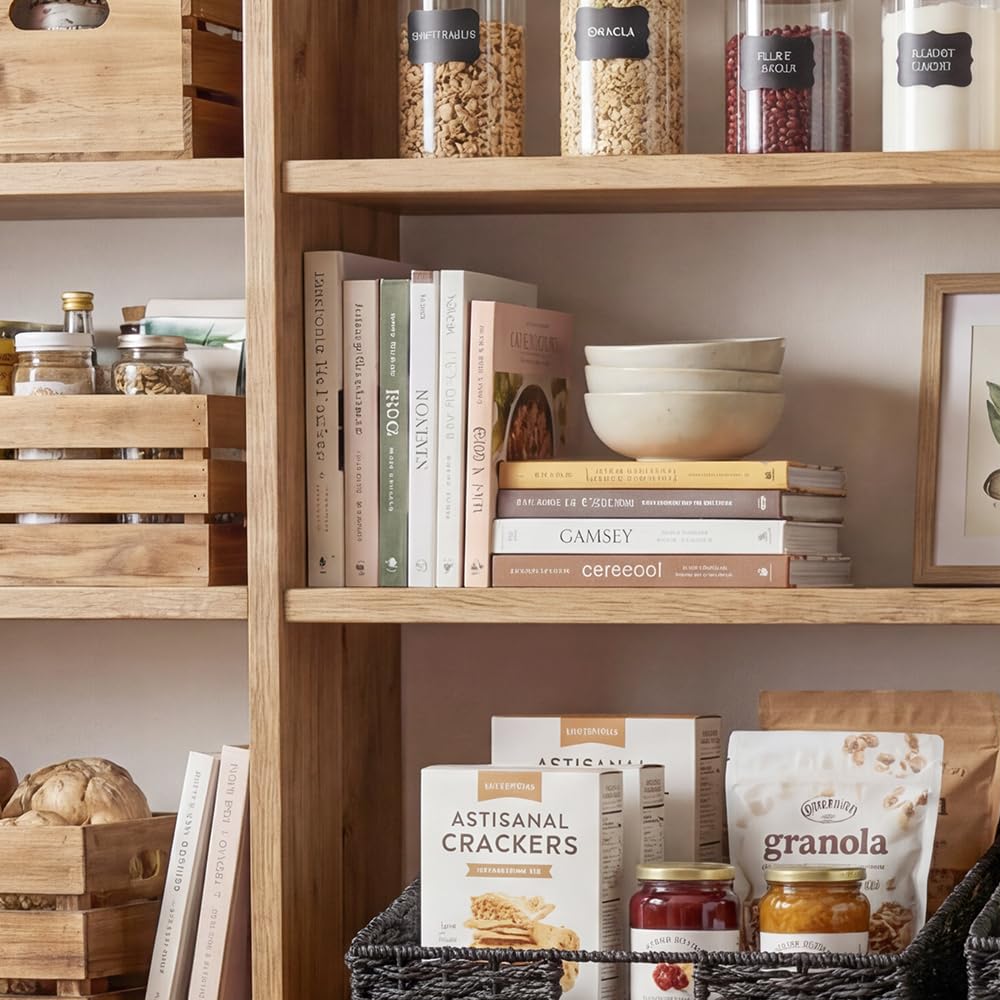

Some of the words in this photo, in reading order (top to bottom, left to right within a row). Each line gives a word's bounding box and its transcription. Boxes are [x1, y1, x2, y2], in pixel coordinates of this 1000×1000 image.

[559, 528, 633, 545] GAMSEY
[451, 811, 569, 830] ASTISANAL
[442, 833, 579, 856] CRACKERS
[763, 828, 889, 862] granola
